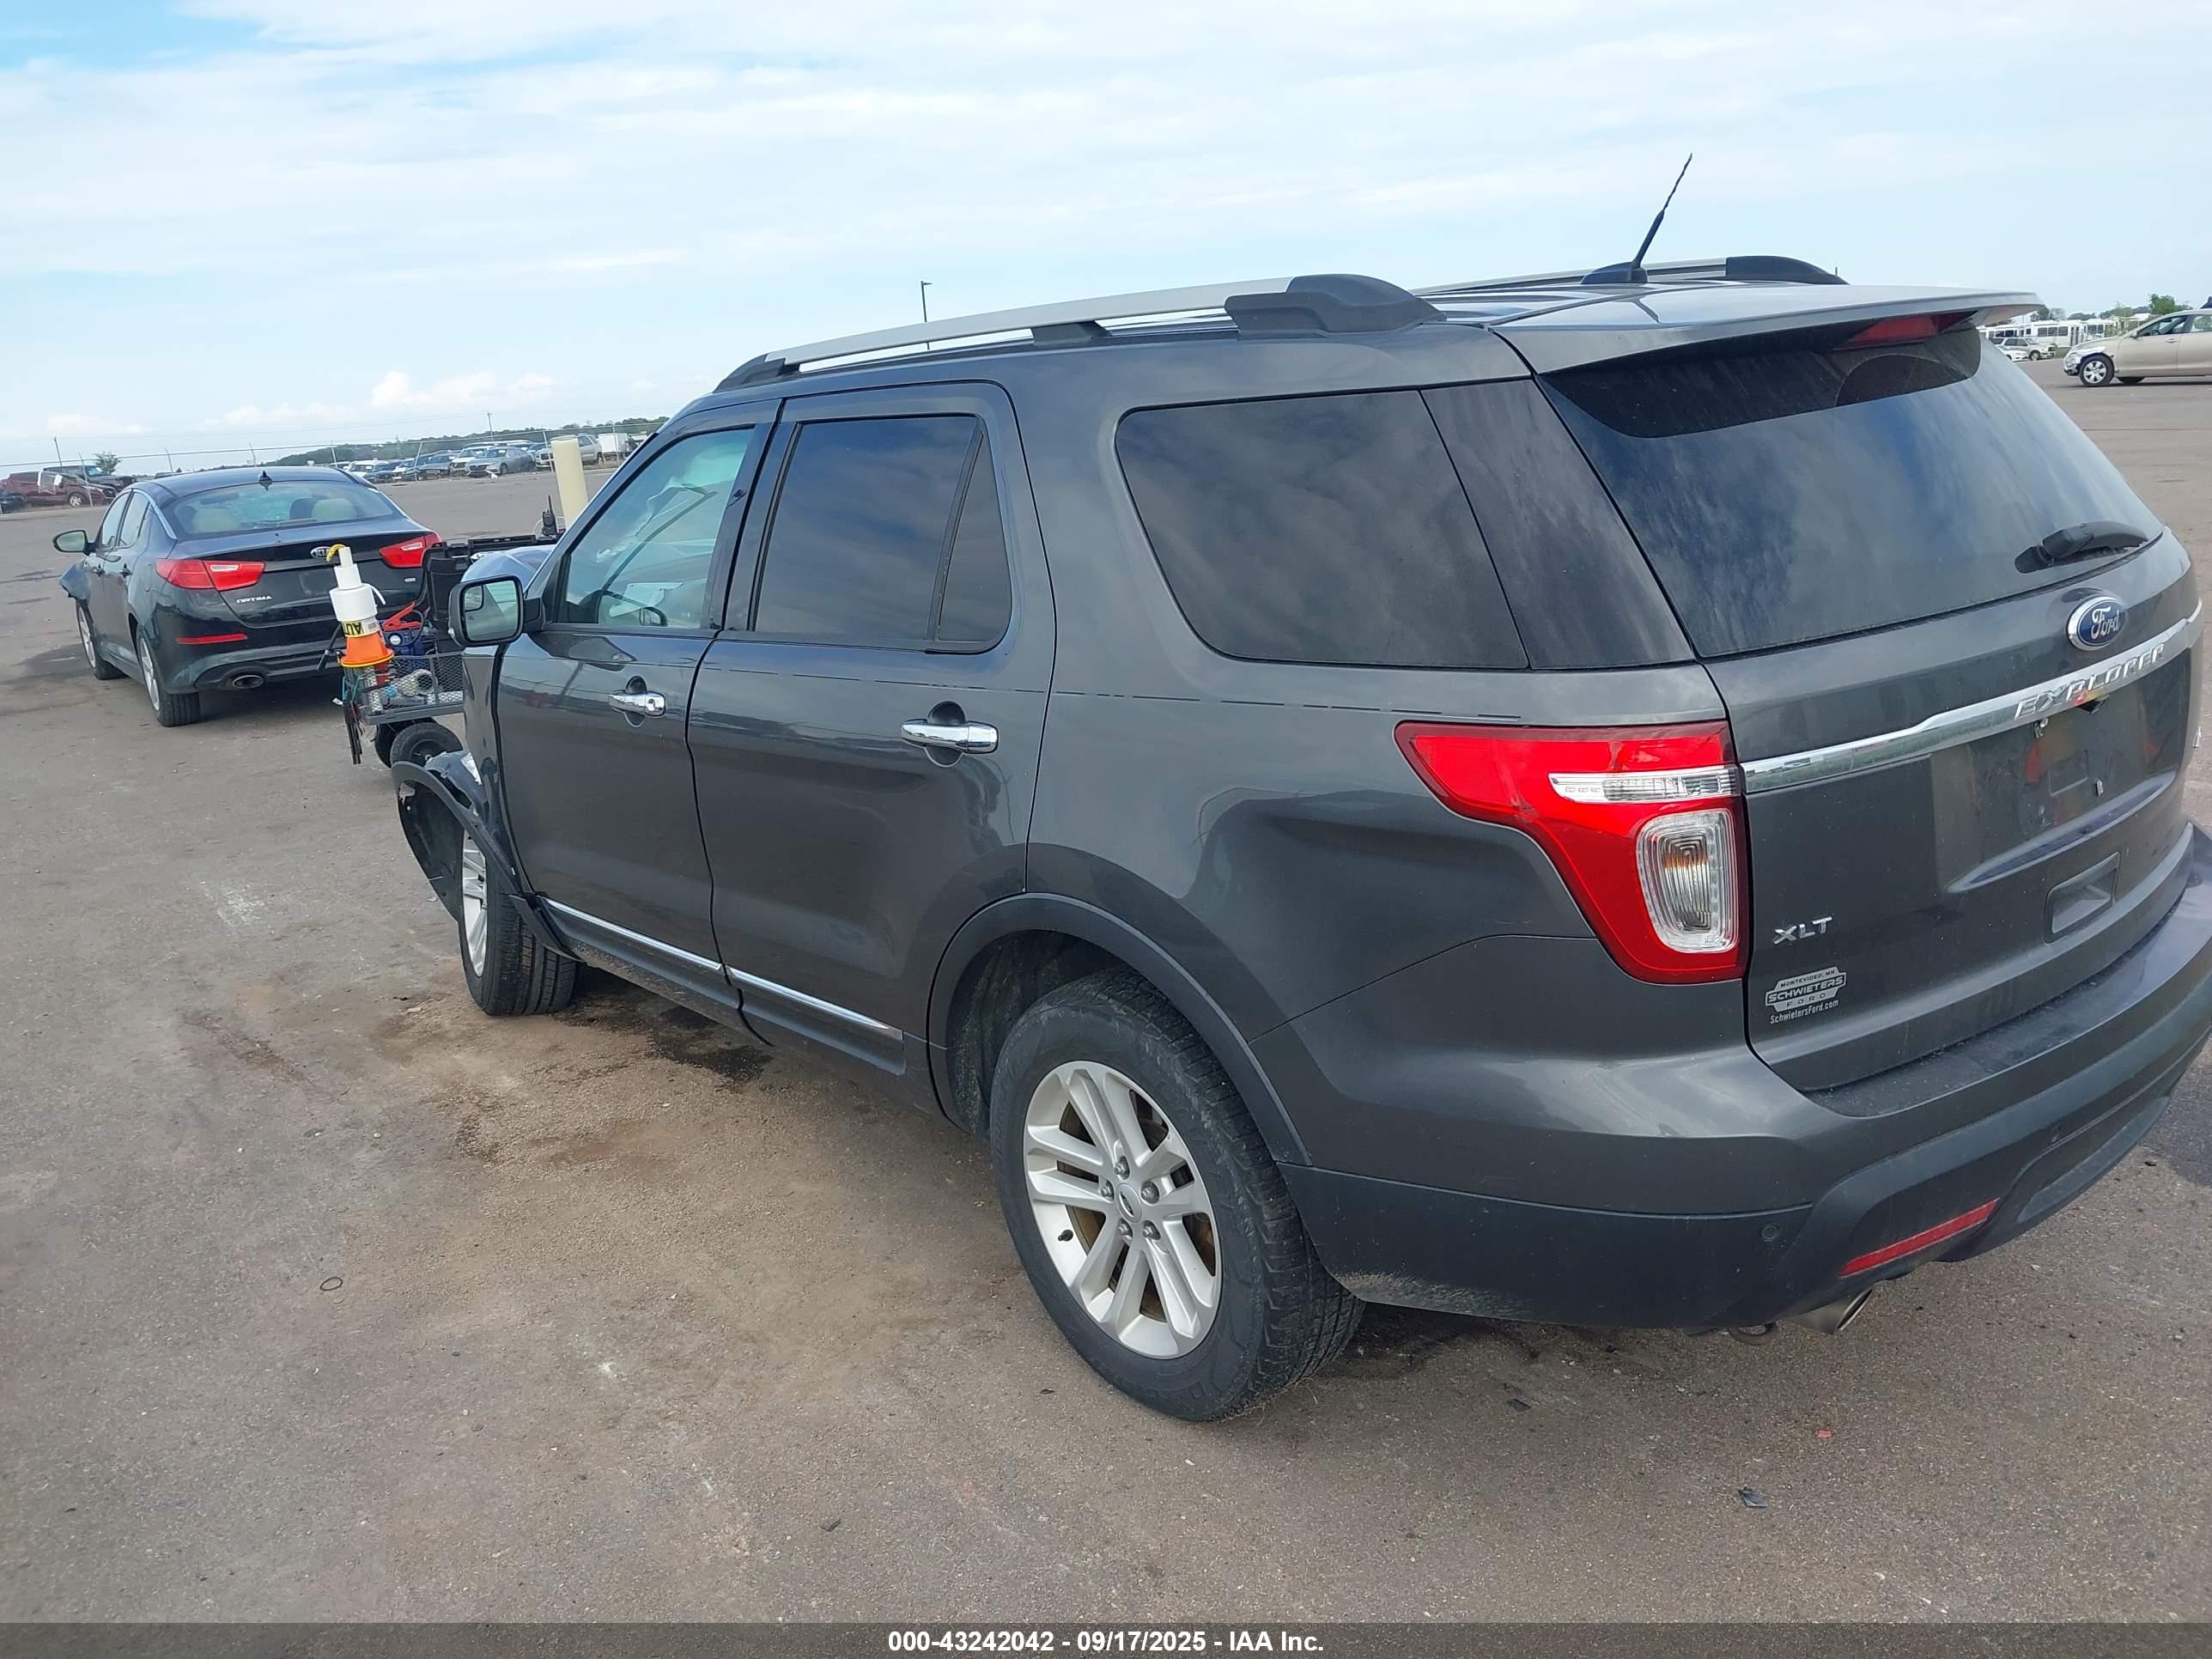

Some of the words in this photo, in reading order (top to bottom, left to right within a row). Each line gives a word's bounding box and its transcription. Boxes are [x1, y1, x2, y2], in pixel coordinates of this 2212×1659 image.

[236, 595, 272, 604] OPTIMA
[2091, 605, 2120, 639] Ford
[2014, 643, 2165, 720] EXPLORER
[1772, 916, 1832, 945] XLT
[1768, 975, 1844, 1003] SCHWIETERS
[1786, 993, 1826, 1007] FORD
[1770, 1000, 1839, 1024] SchwietersFord.com
